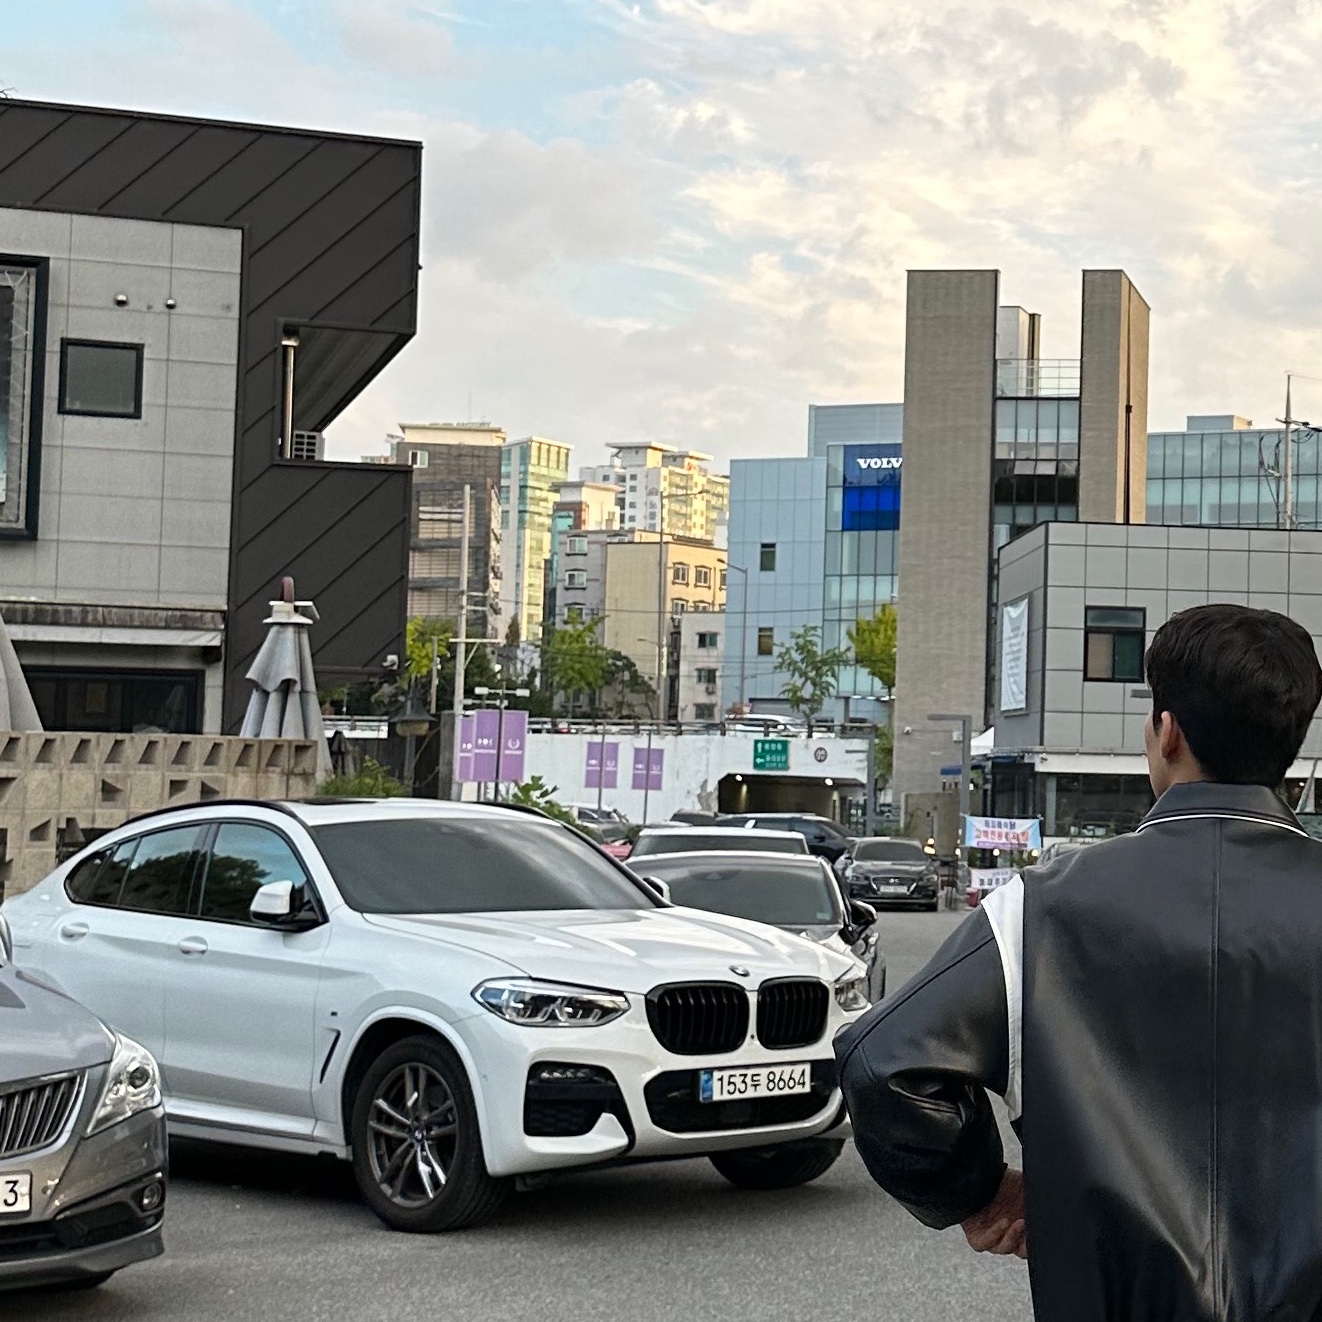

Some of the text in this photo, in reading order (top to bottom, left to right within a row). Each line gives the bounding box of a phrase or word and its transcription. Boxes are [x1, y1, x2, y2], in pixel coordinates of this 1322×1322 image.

[716, 1068, 806, 1096] 153두 8664
[3, 1179, 19, 1207] 3
